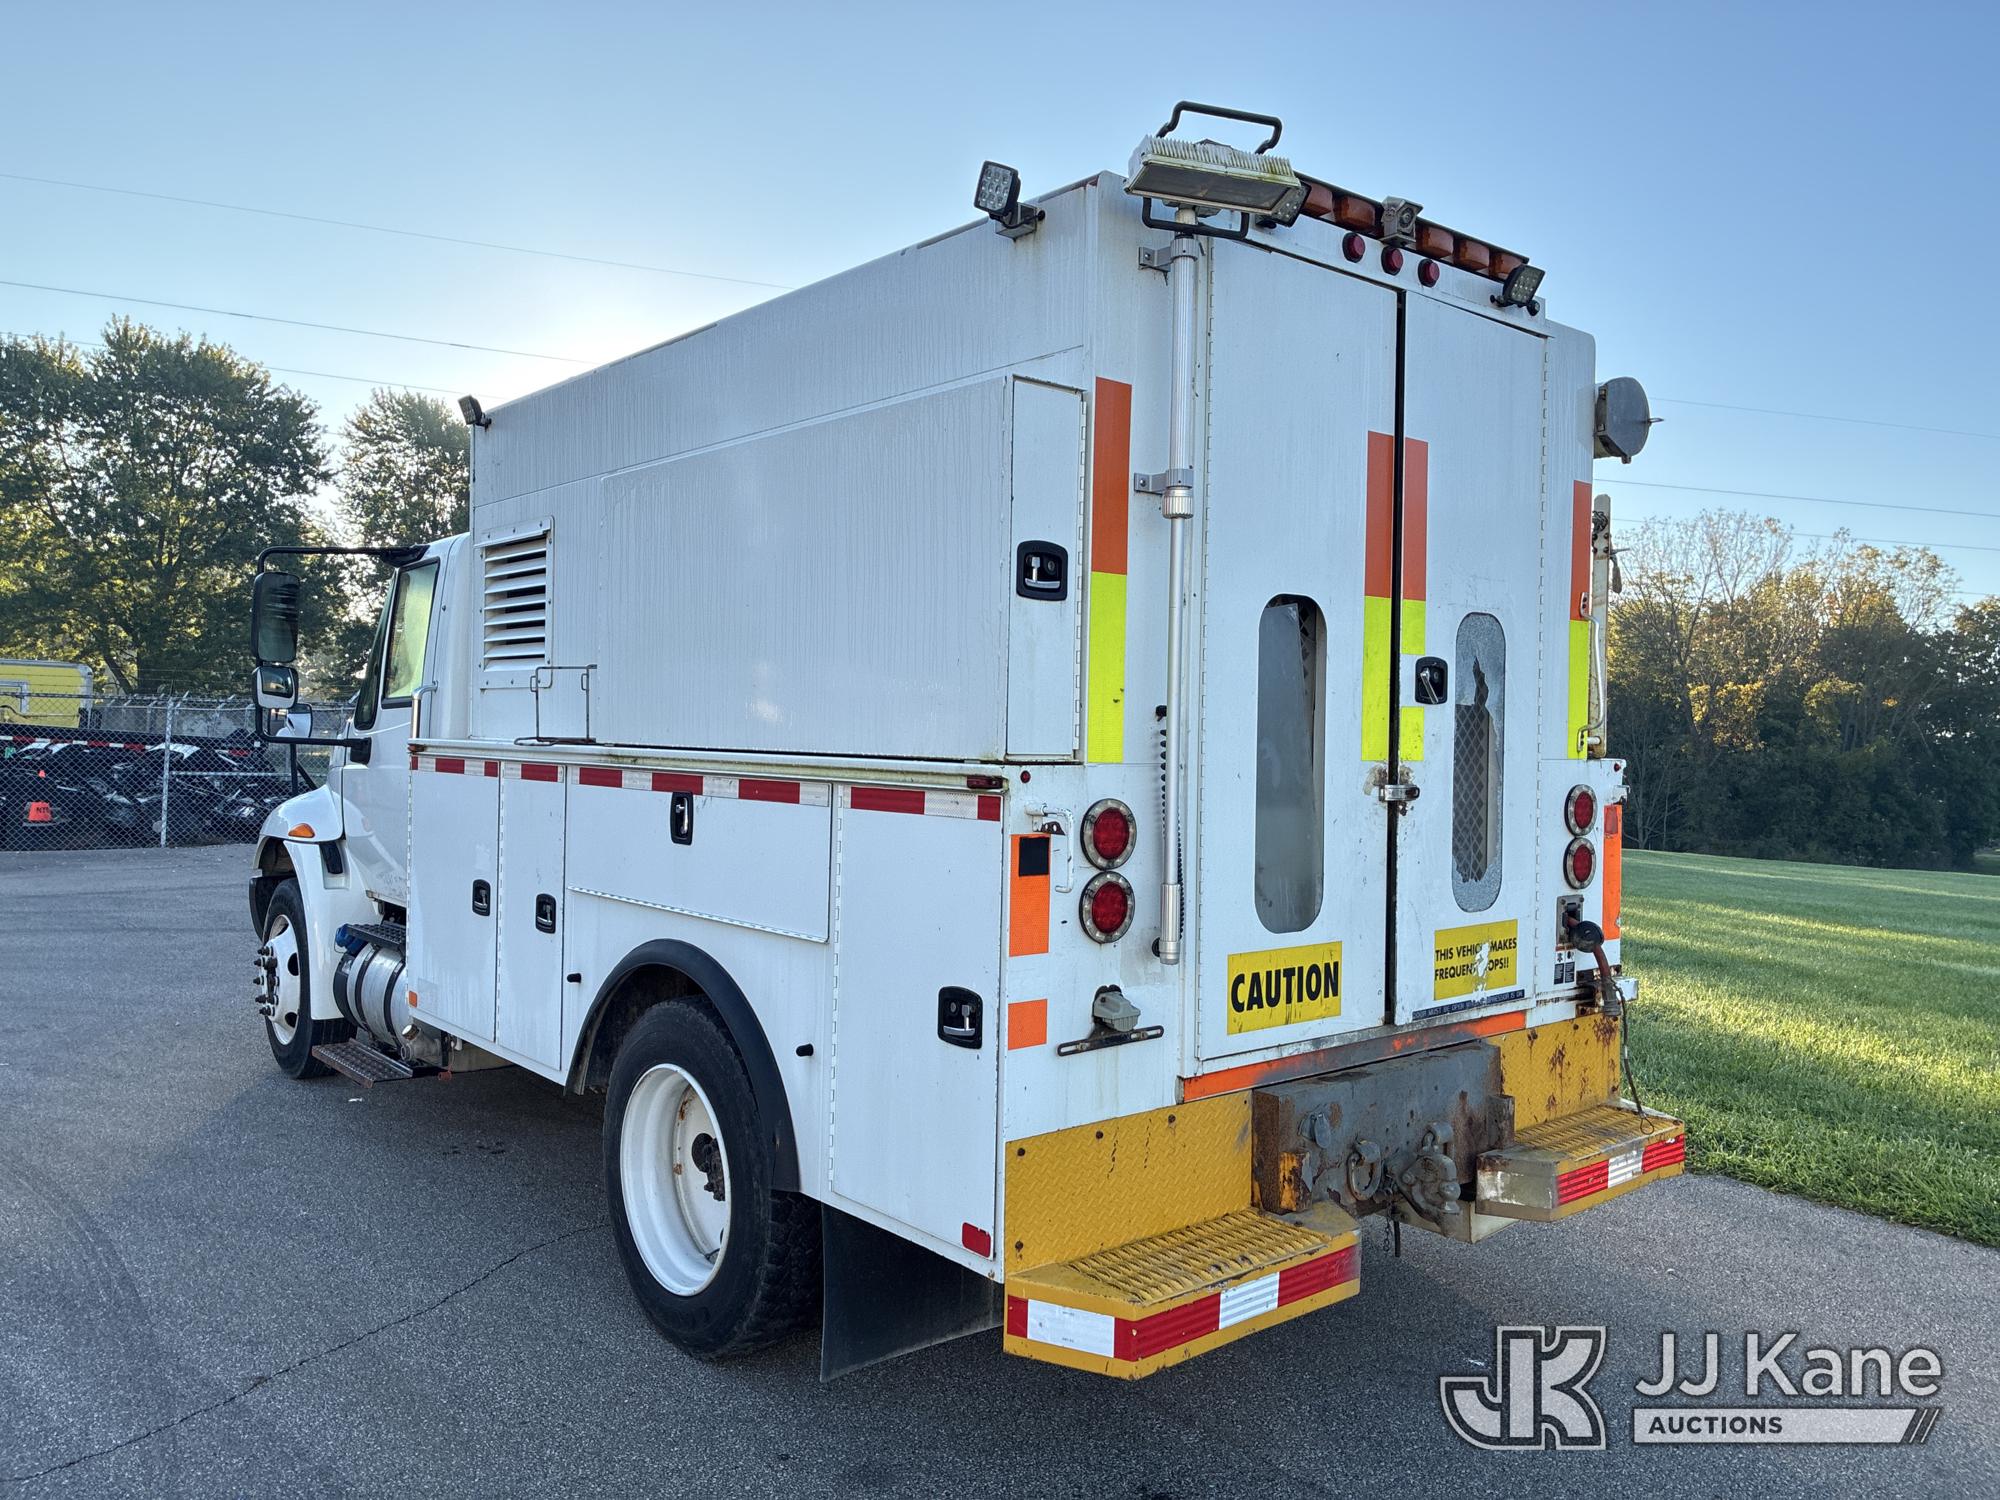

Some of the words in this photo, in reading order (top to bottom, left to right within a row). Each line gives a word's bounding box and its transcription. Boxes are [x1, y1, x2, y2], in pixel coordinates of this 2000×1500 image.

[1435, 947, 1454, 961] THIS
[1456, 942, 1485, 958] VEHIC
[1490, 937, 1517, 953] MAKES
[1435, 963, 1477, 980] FREQUEN
[1484, 957, 1509, 972] OPS!!
[1230, 961, 1339, 1013] CAUTION
